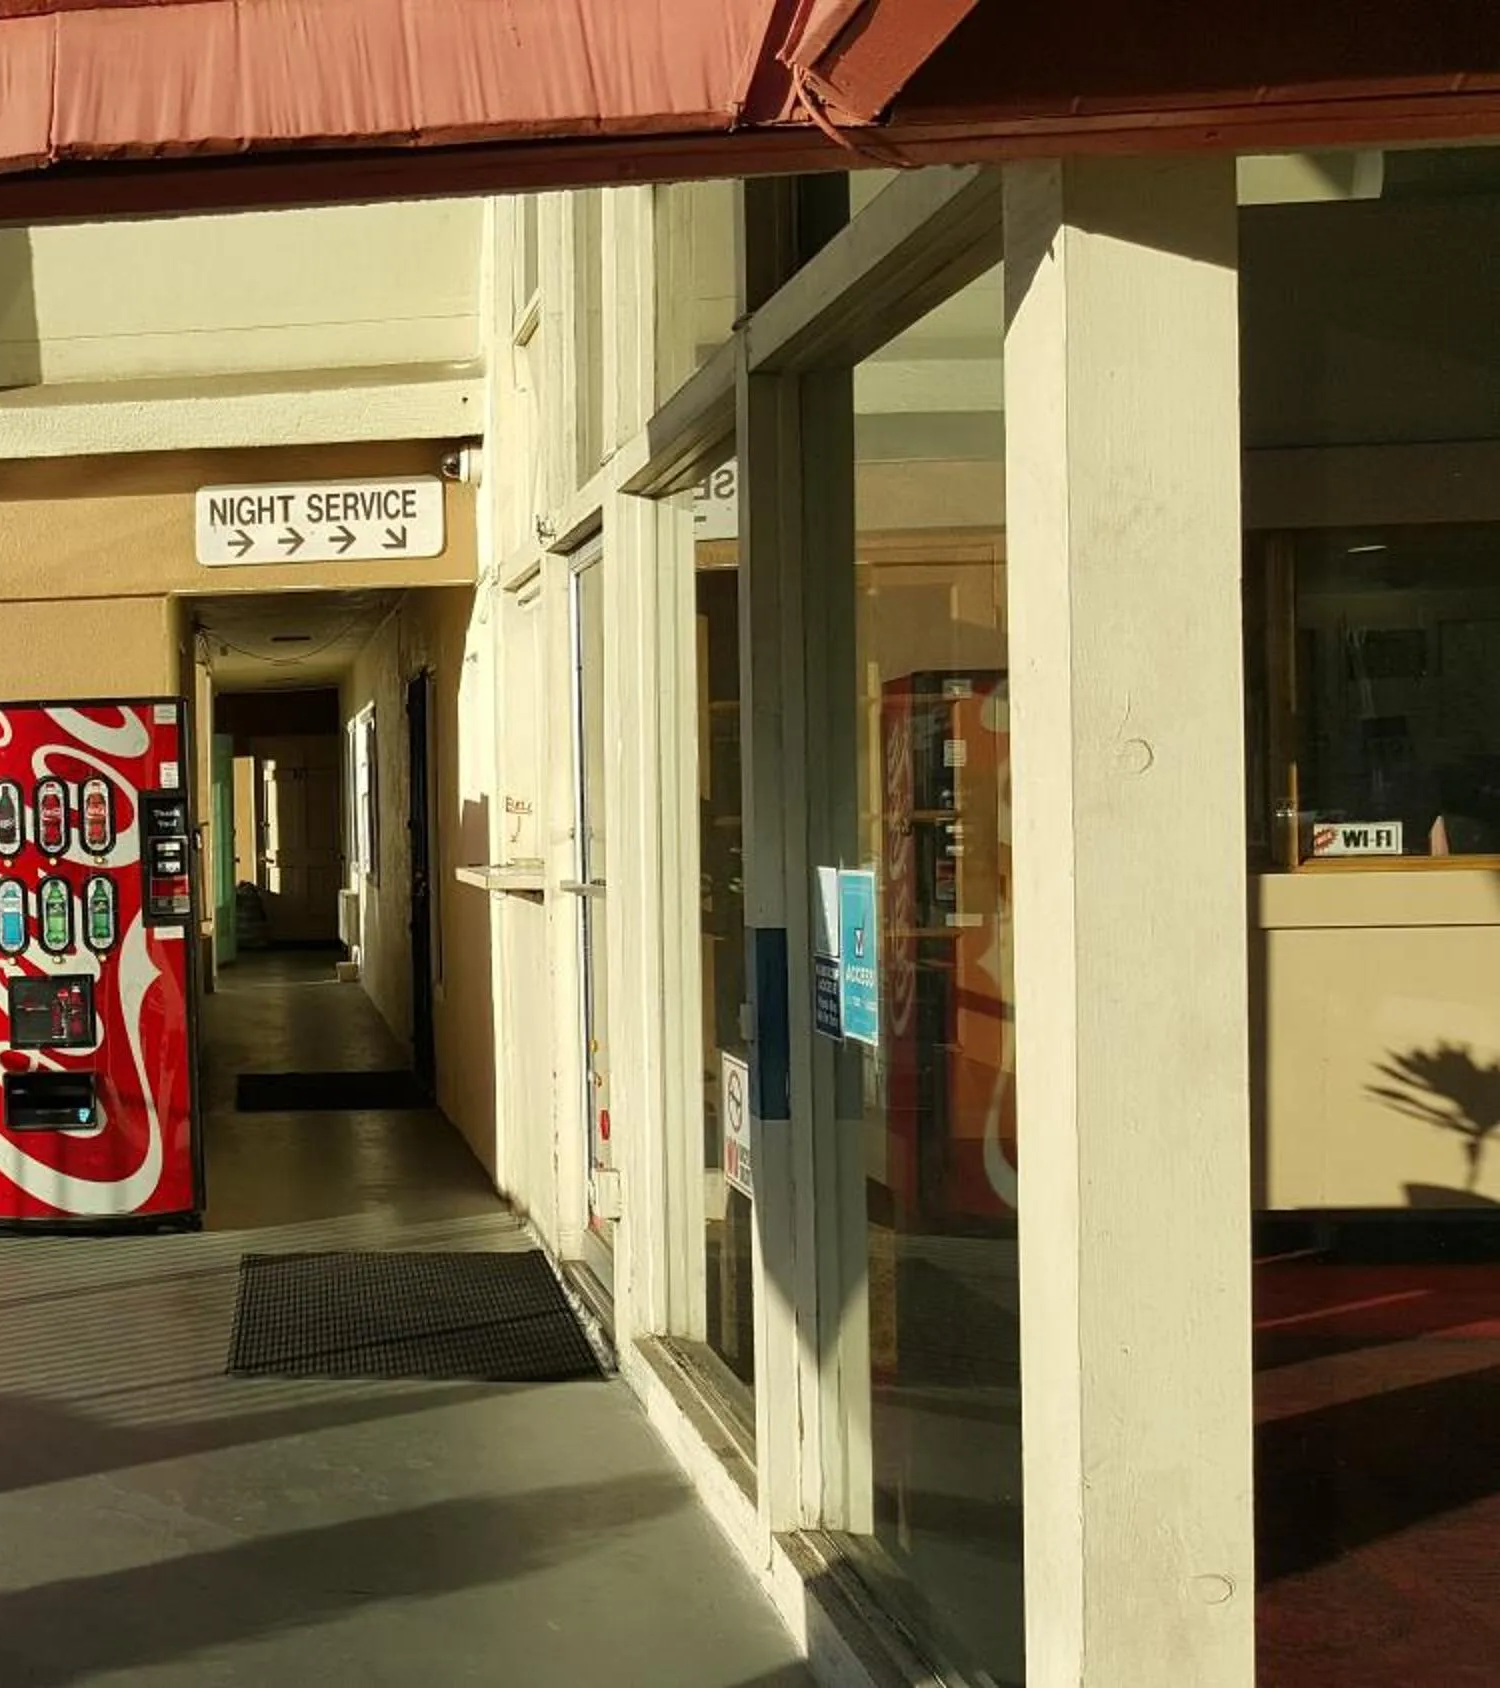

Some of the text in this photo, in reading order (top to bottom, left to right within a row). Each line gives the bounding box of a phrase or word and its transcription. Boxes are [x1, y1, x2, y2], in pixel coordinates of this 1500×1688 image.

[209, 490, 416, 526] NIGHT SERVICE
[1342, 829, 1392, 848] WI-FI
